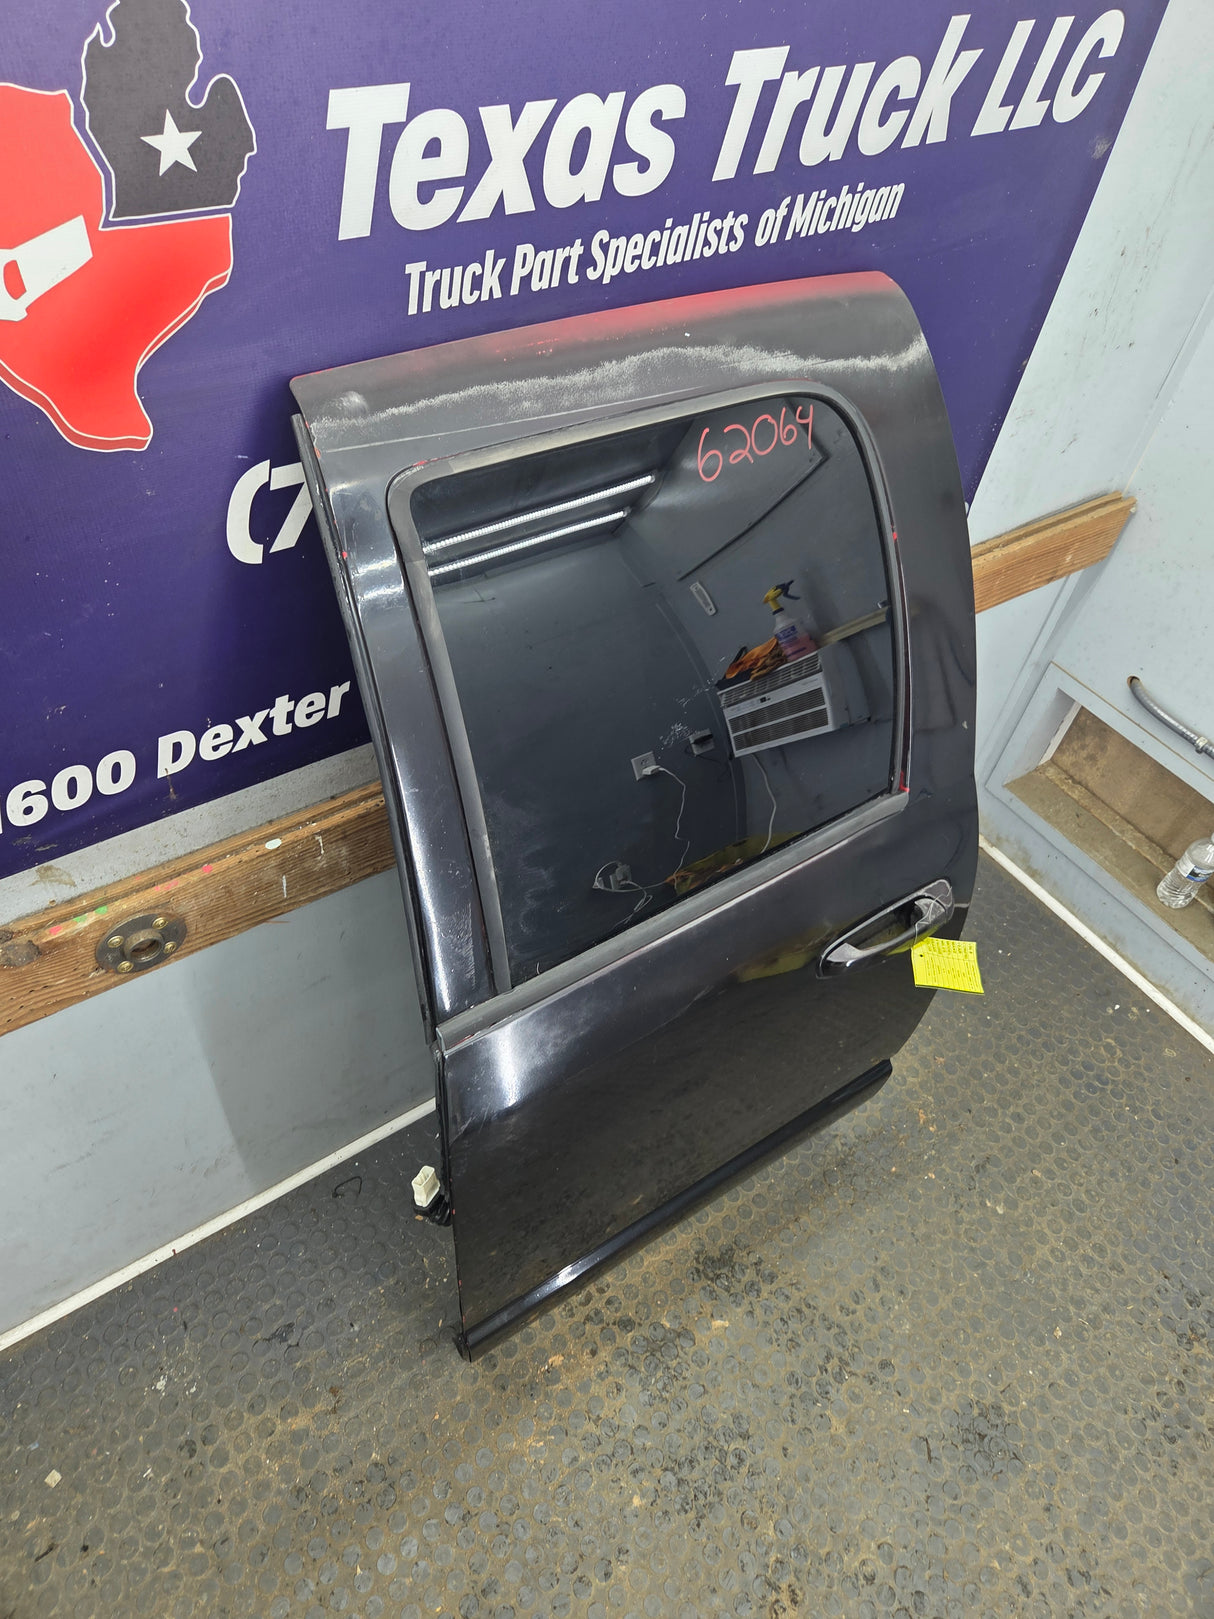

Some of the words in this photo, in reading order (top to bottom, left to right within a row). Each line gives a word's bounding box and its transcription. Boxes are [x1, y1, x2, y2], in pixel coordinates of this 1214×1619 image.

[325, 81, 687, 241] Texas
[711, 13, 985, 182] Truck
[970, 9, 1126, 137] LLC
[404, 249, 507, 316] Truck
[509, 238, 585, 296] Part
[586, 210, 749, 285] Specialists
[754, 195, 792, 247] of
[784, 182, 906, 241] Michigan
[697, 404, 814, 482] 62064
[0, 749, 136, 835] 600
[157, 680, 351, 779] Dexter
